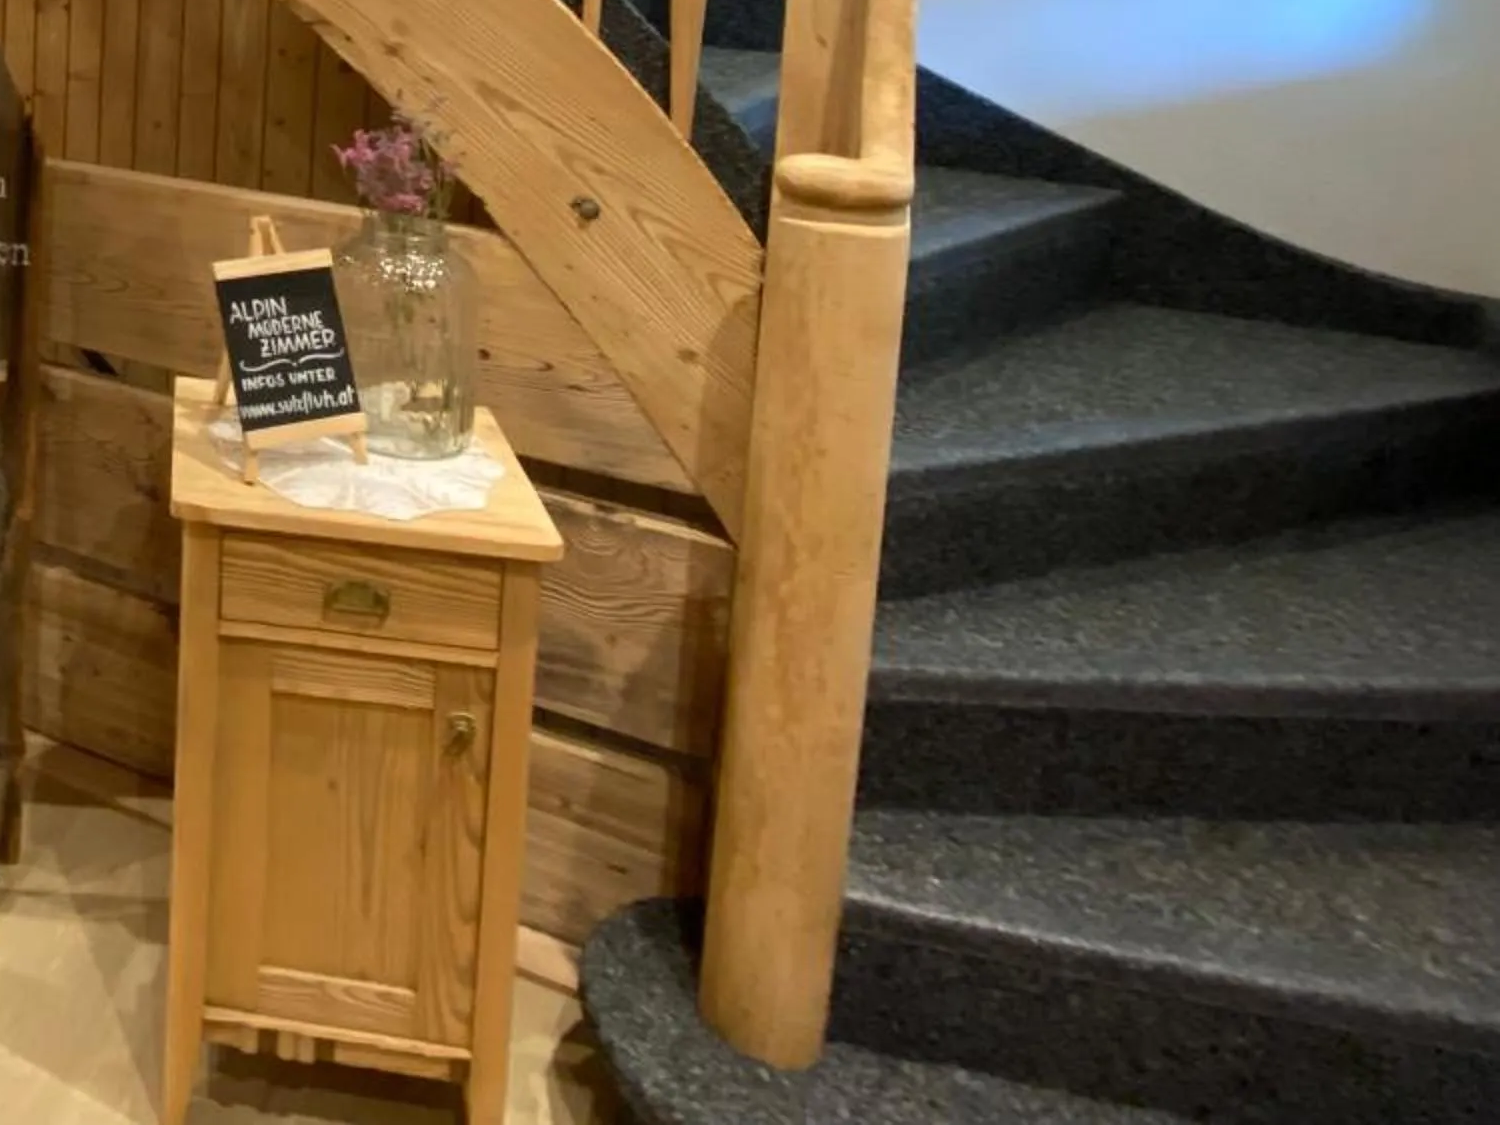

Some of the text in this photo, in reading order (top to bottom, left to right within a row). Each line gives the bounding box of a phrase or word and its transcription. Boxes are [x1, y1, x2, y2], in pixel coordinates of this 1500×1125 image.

[229, 296, 288, 324] ALPIN
[248, 310, 324, 341] MODERNE
[260, 328, 337, 358] ZIMMER
[241, 366, 338, 392] INFOS UNTER
